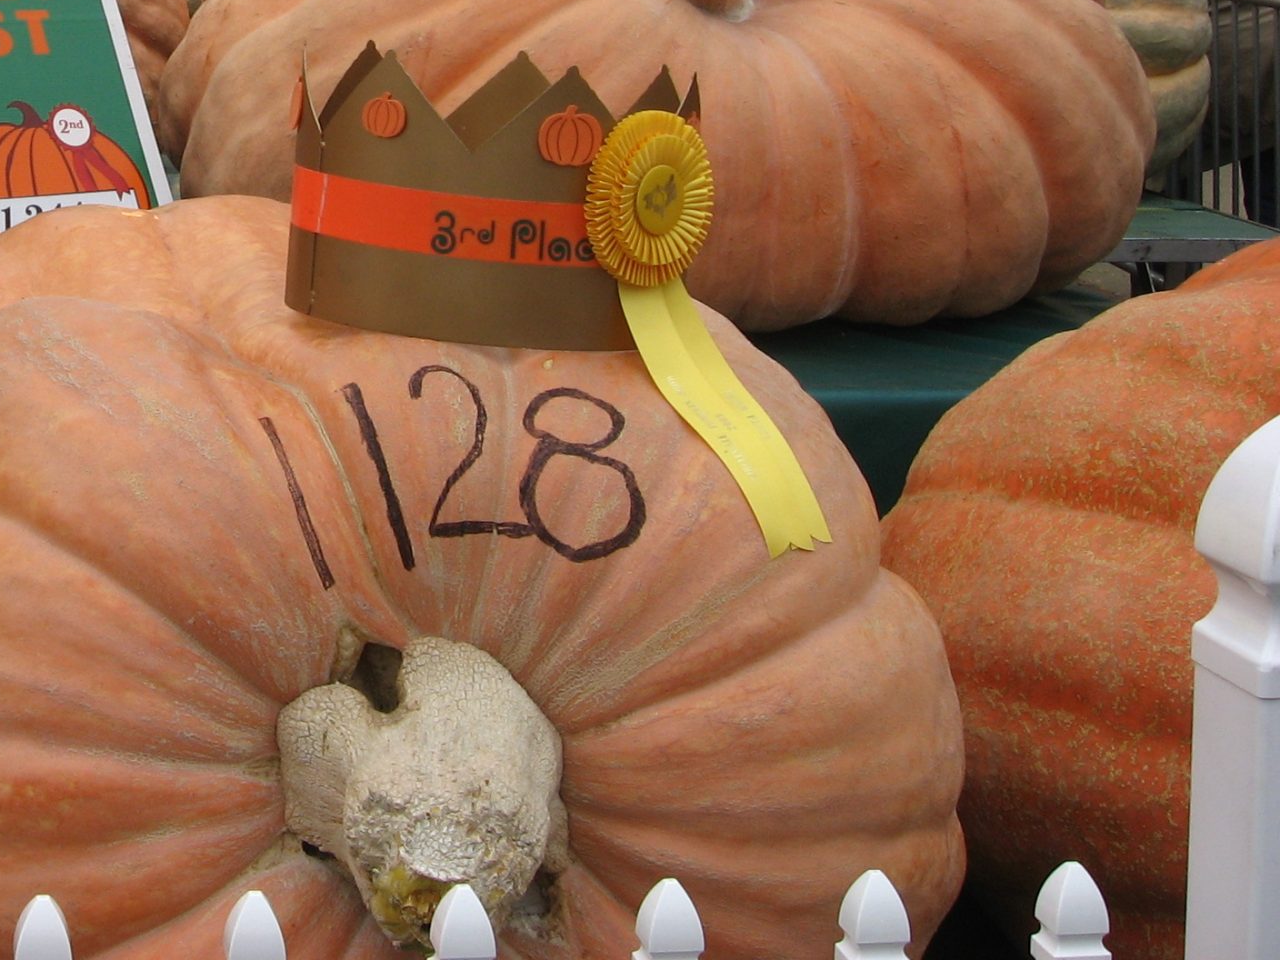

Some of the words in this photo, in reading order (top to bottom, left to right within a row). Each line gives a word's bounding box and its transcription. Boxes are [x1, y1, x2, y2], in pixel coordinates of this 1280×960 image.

[57, 117, 85, 135] 2nd
[430, 210, 496, 255] 3rd
[509, 218, 595, 263] Plac
[258, 363, 648, 590] 1128
